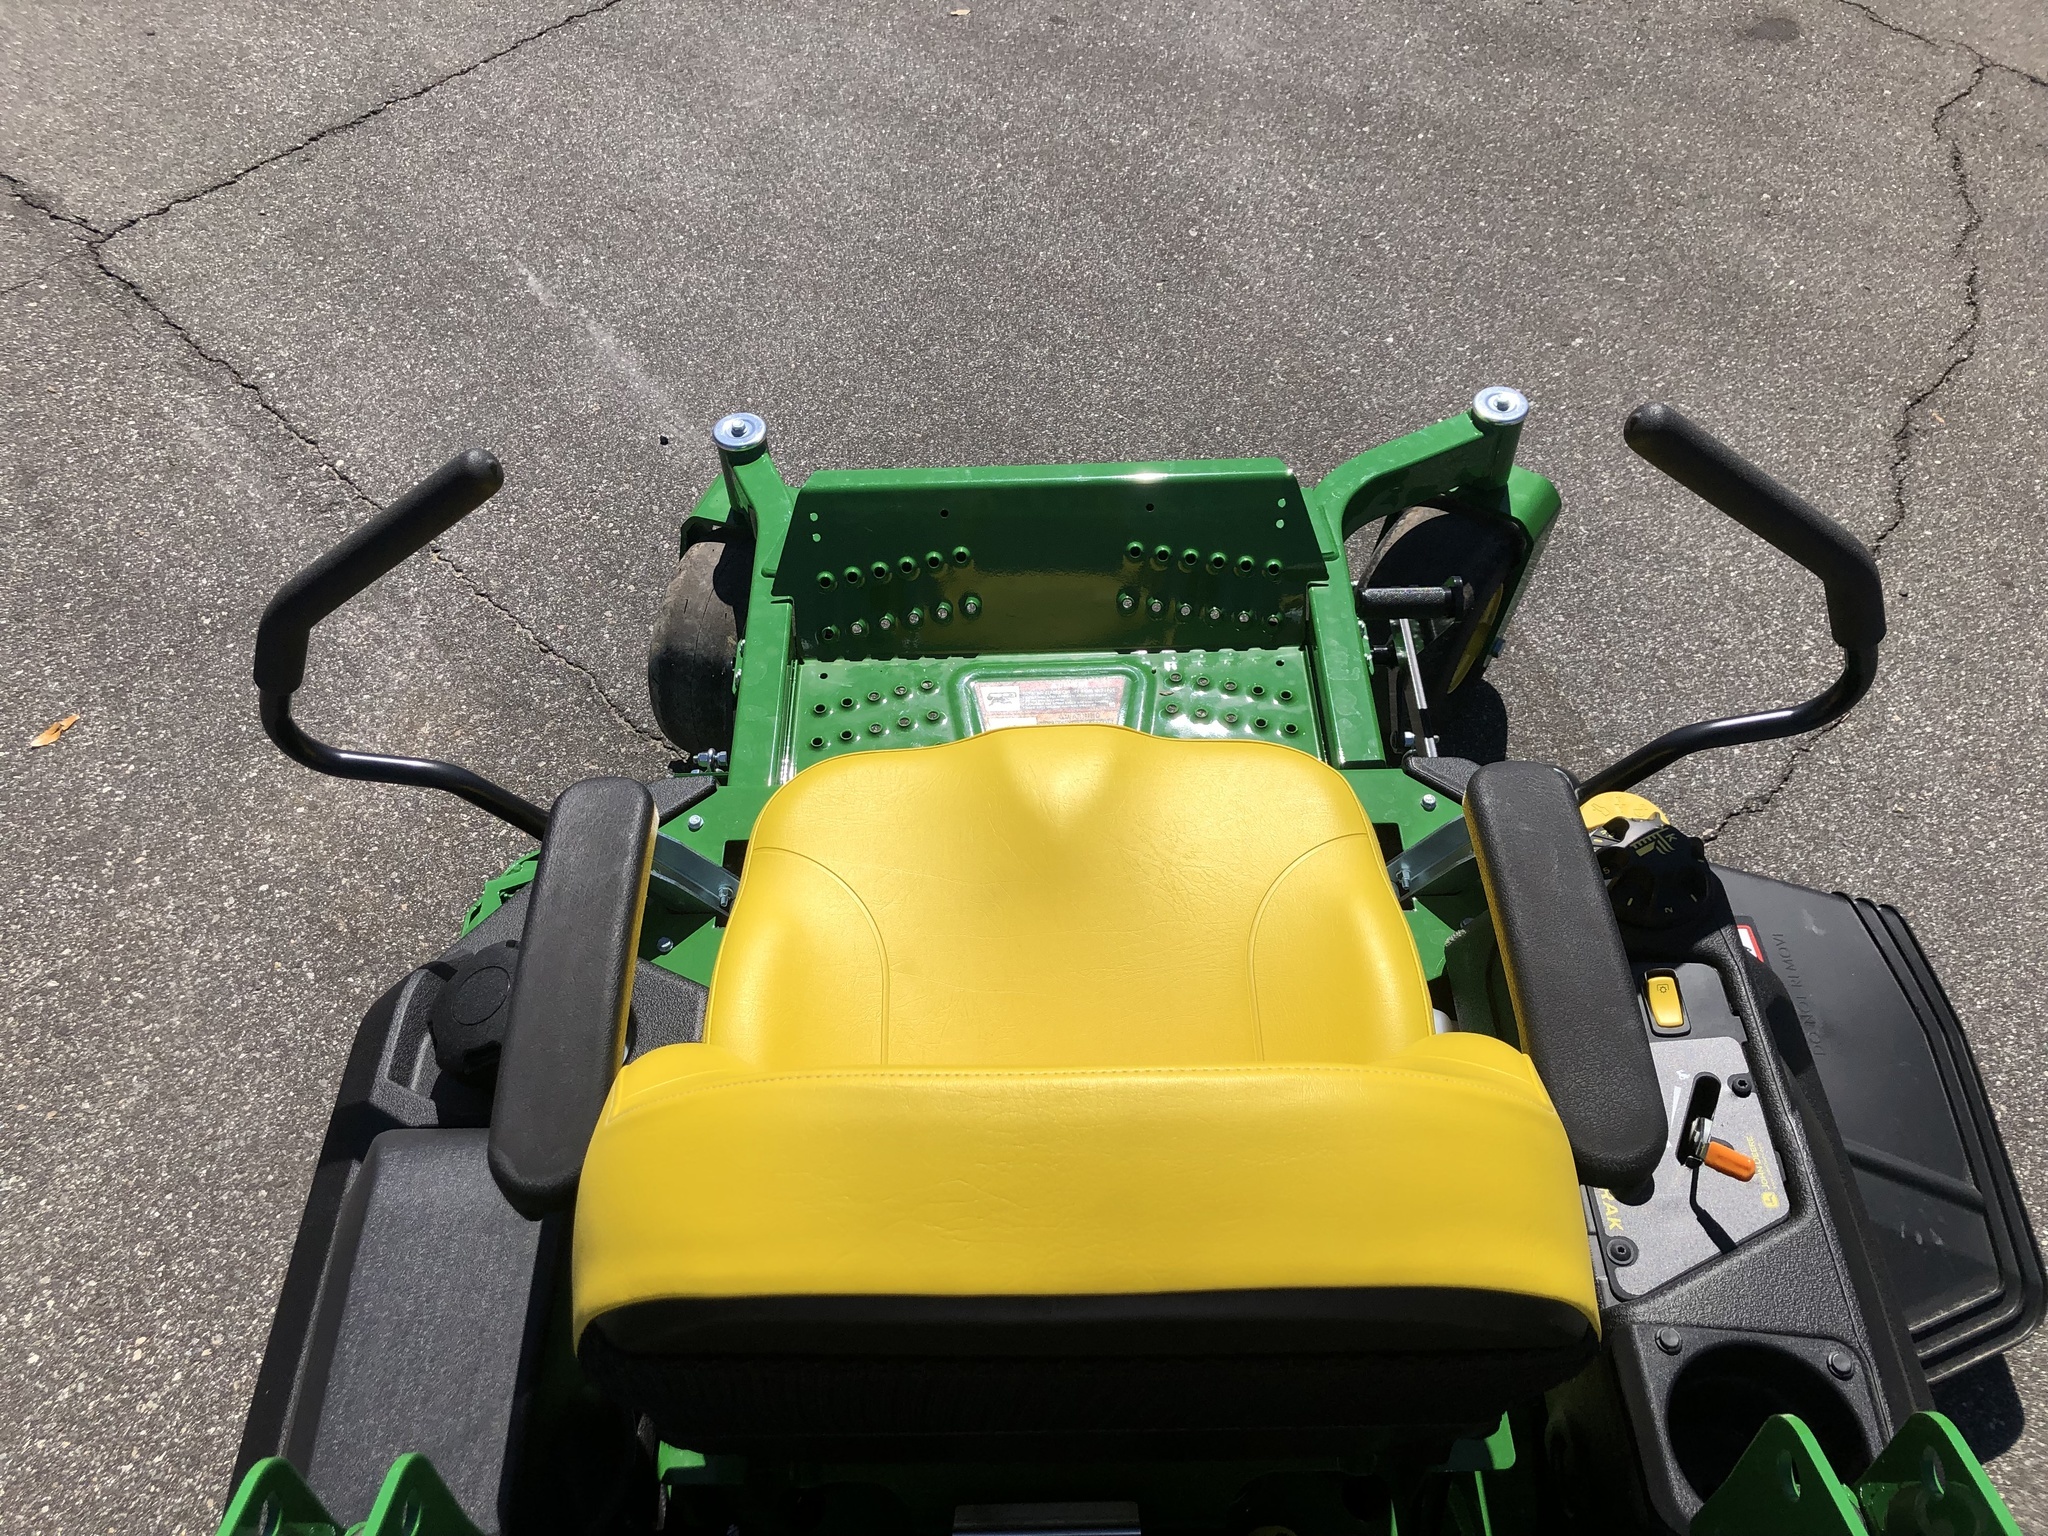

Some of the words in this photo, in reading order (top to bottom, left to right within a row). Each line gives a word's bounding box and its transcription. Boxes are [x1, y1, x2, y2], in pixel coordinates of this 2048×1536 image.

[1664, 906, 1674, 914] 2
[1745, 1135, 1760, 1164] DEERE
[1755, 1165, 1770, 1190] JOHN
